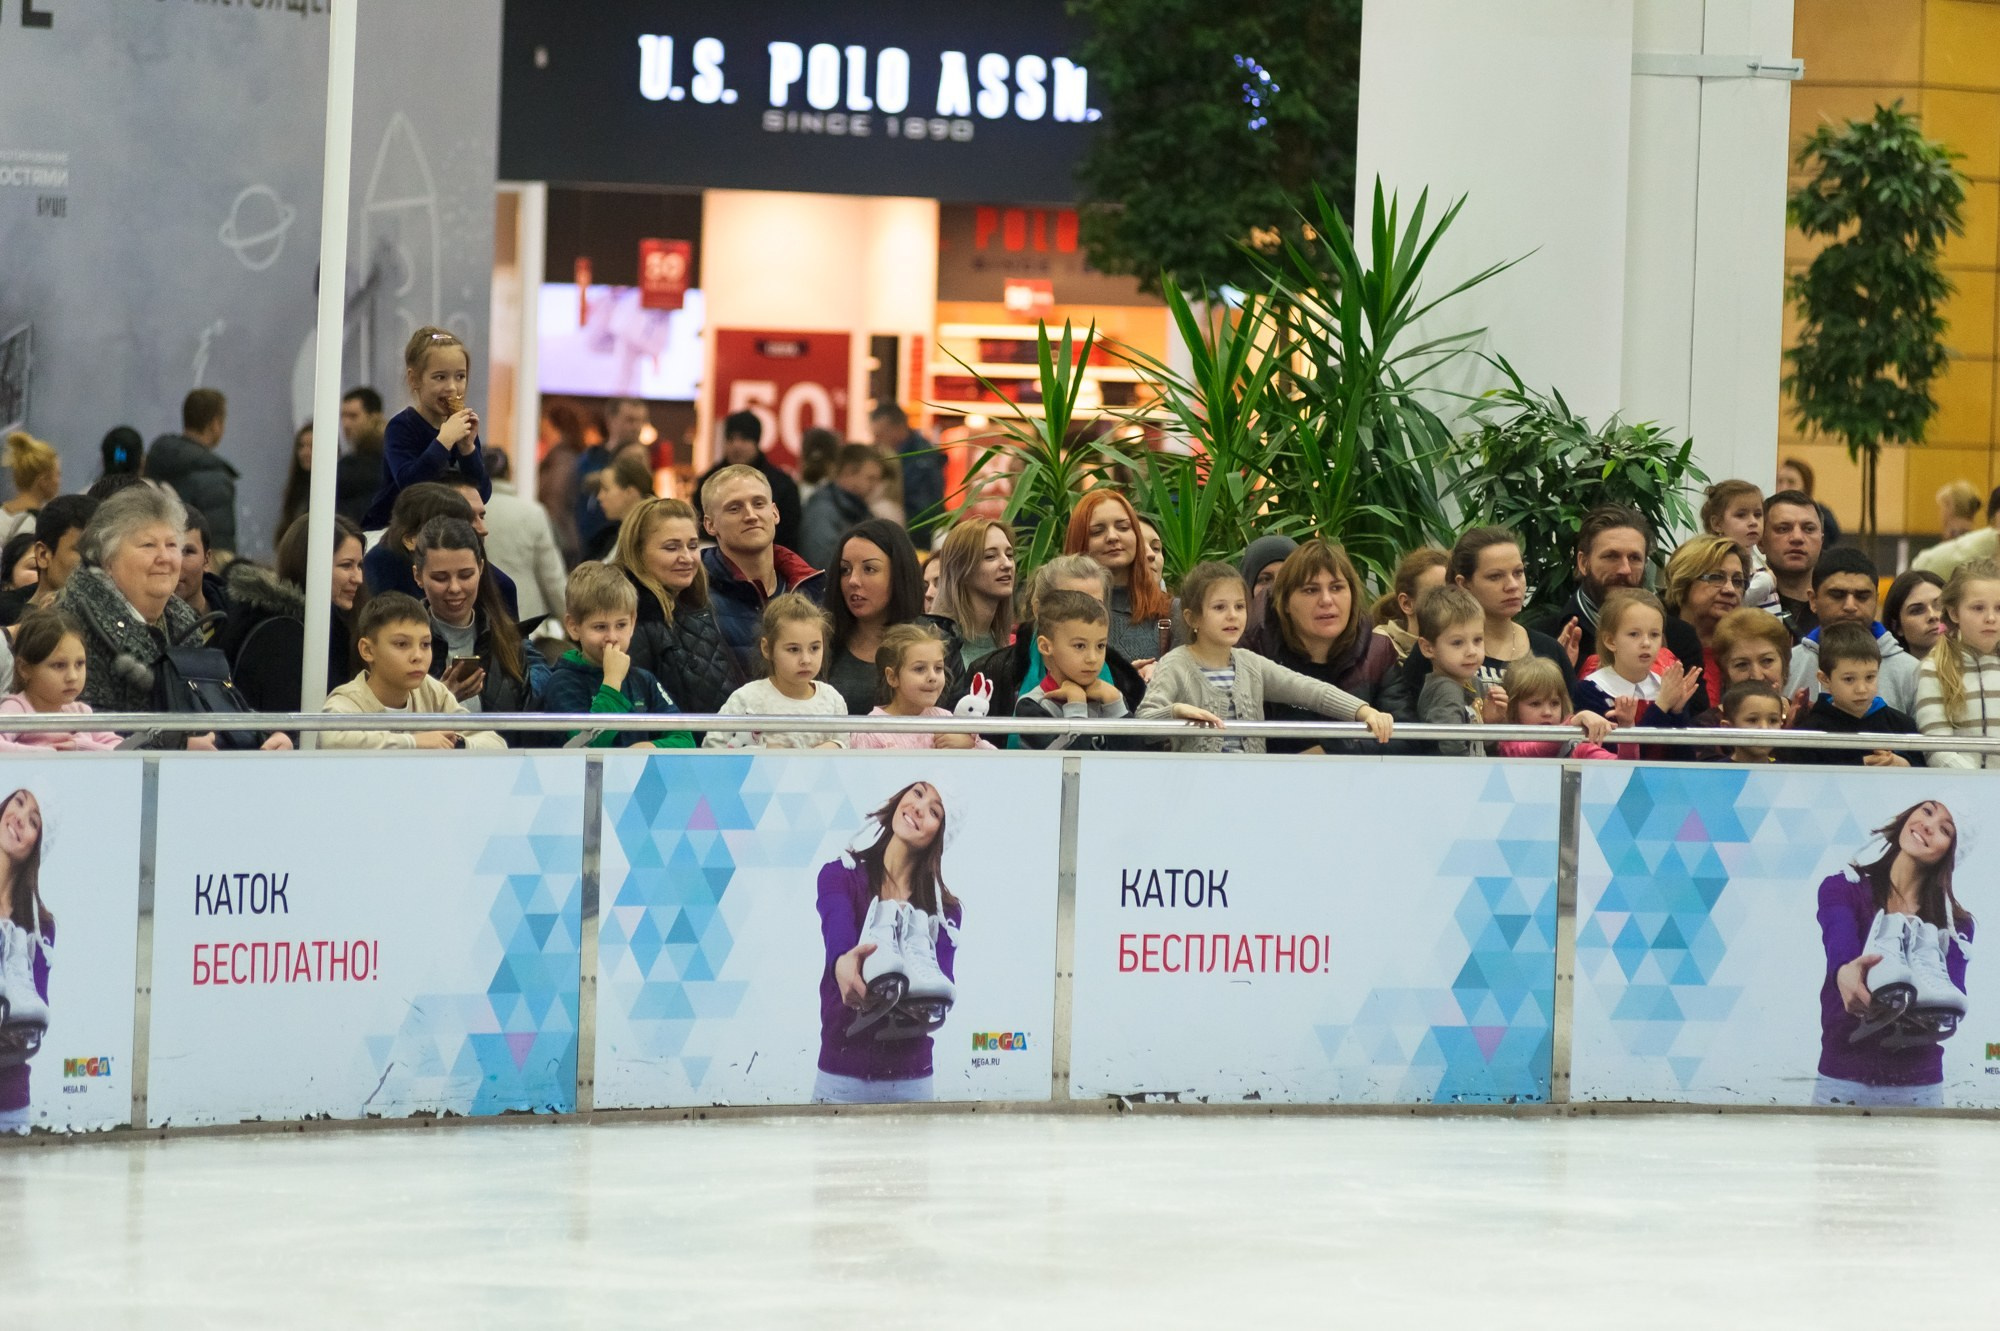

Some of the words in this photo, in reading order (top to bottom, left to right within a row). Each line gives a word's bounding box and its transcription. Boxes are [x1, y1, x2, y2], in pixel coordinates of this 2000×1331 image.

[638, 34, 738, 104] U.S.
[768, 41, 910, 114] POLO
[762, 109, 872, 137] SINCE
[195, 873, 289, 915] КАТОК
[1121, 868, 1229, 908] КАТОК
[193, 940, 378, 985] БЕСПЛАТНО!
[1119, 933, 1330, 973] БЕСПЛАТНО!
[972, 1057, 1000, 1067] MEGA.RU
